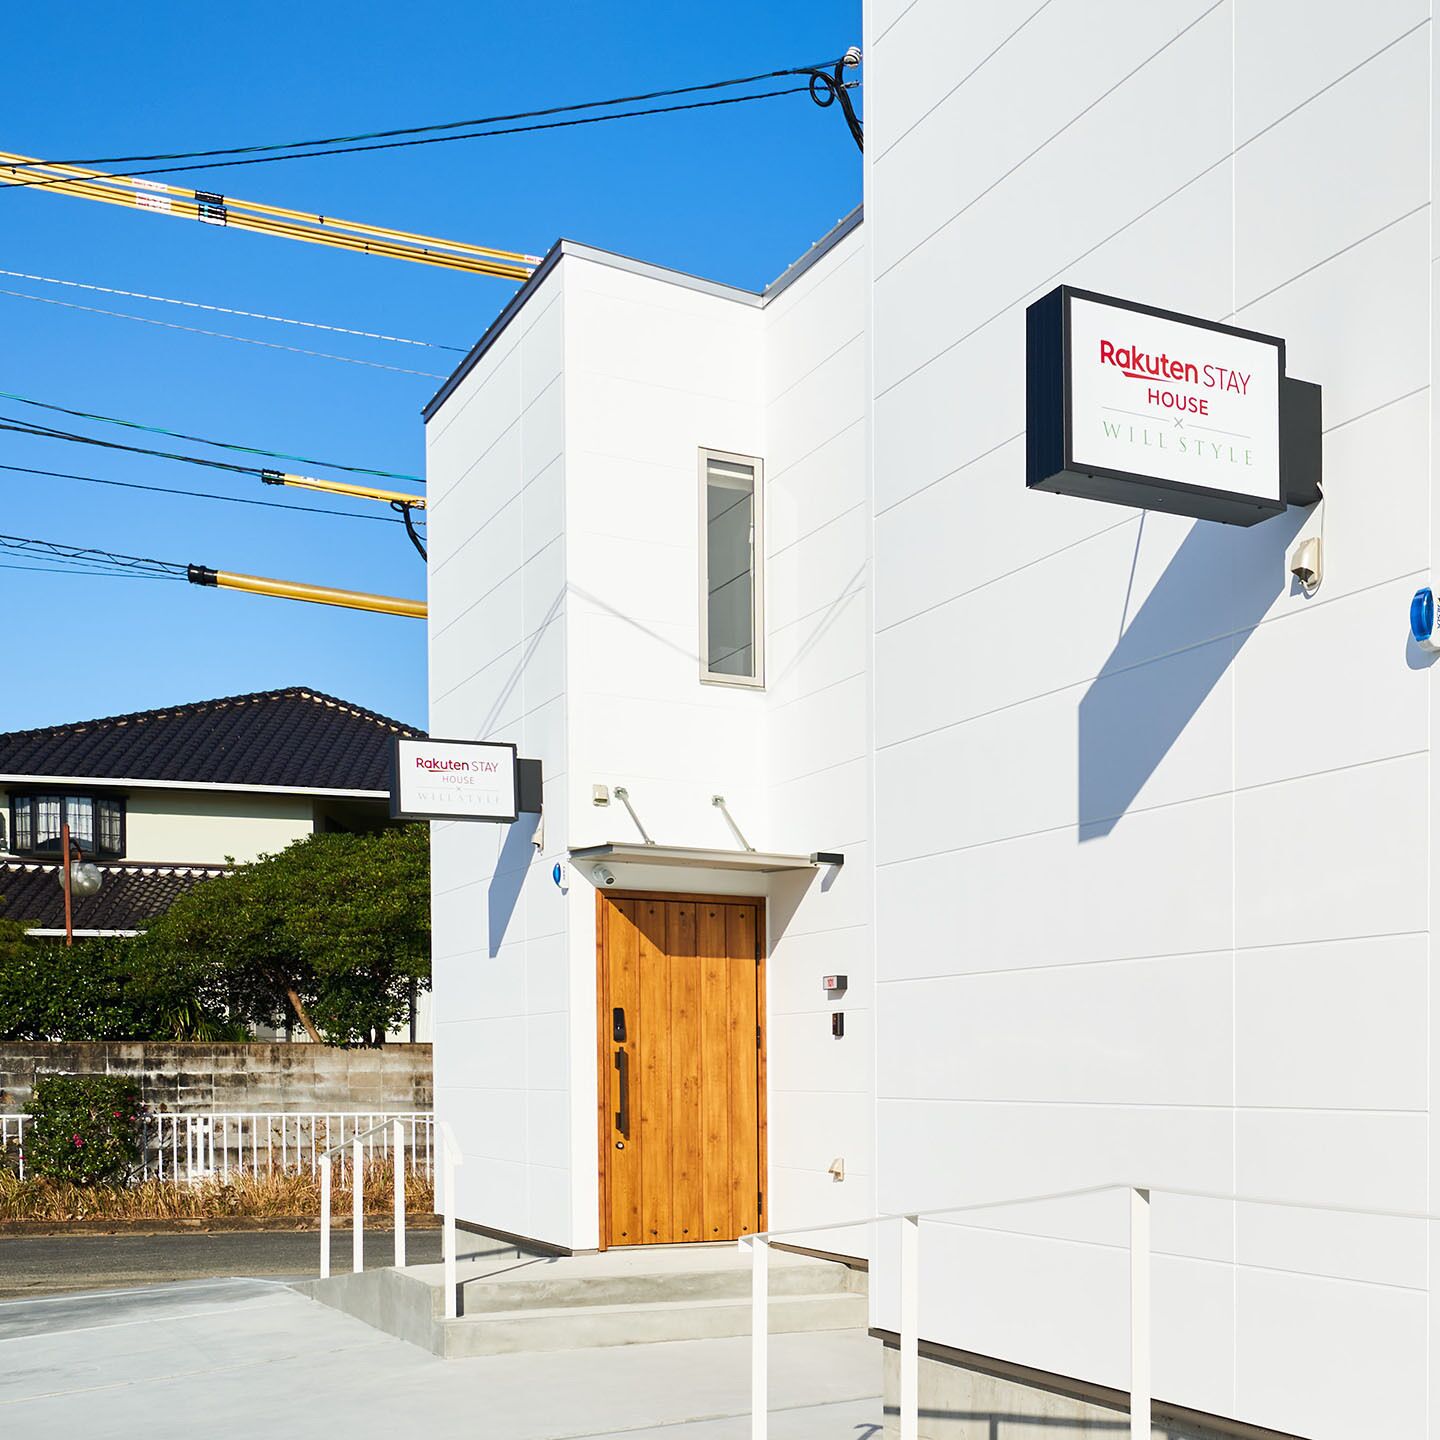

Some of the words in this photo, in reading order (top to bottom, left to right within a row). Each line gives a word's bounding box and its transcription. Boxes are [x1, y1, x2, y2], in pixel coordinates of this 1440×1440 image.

[1100, 339, 1199, 384] Rakuten
[1203, 364, 1251, 395] STAY
[1148, 388, 1209, 416] HOUSE
[1103, 420, 1168, 449] WILL
[1179, 436, 1253, 466] STYLE
[416, 757, 470, 773] Rakuten
[472, 761, 499, 773] STAY
[442, 775, 475, 785] HOUSE
